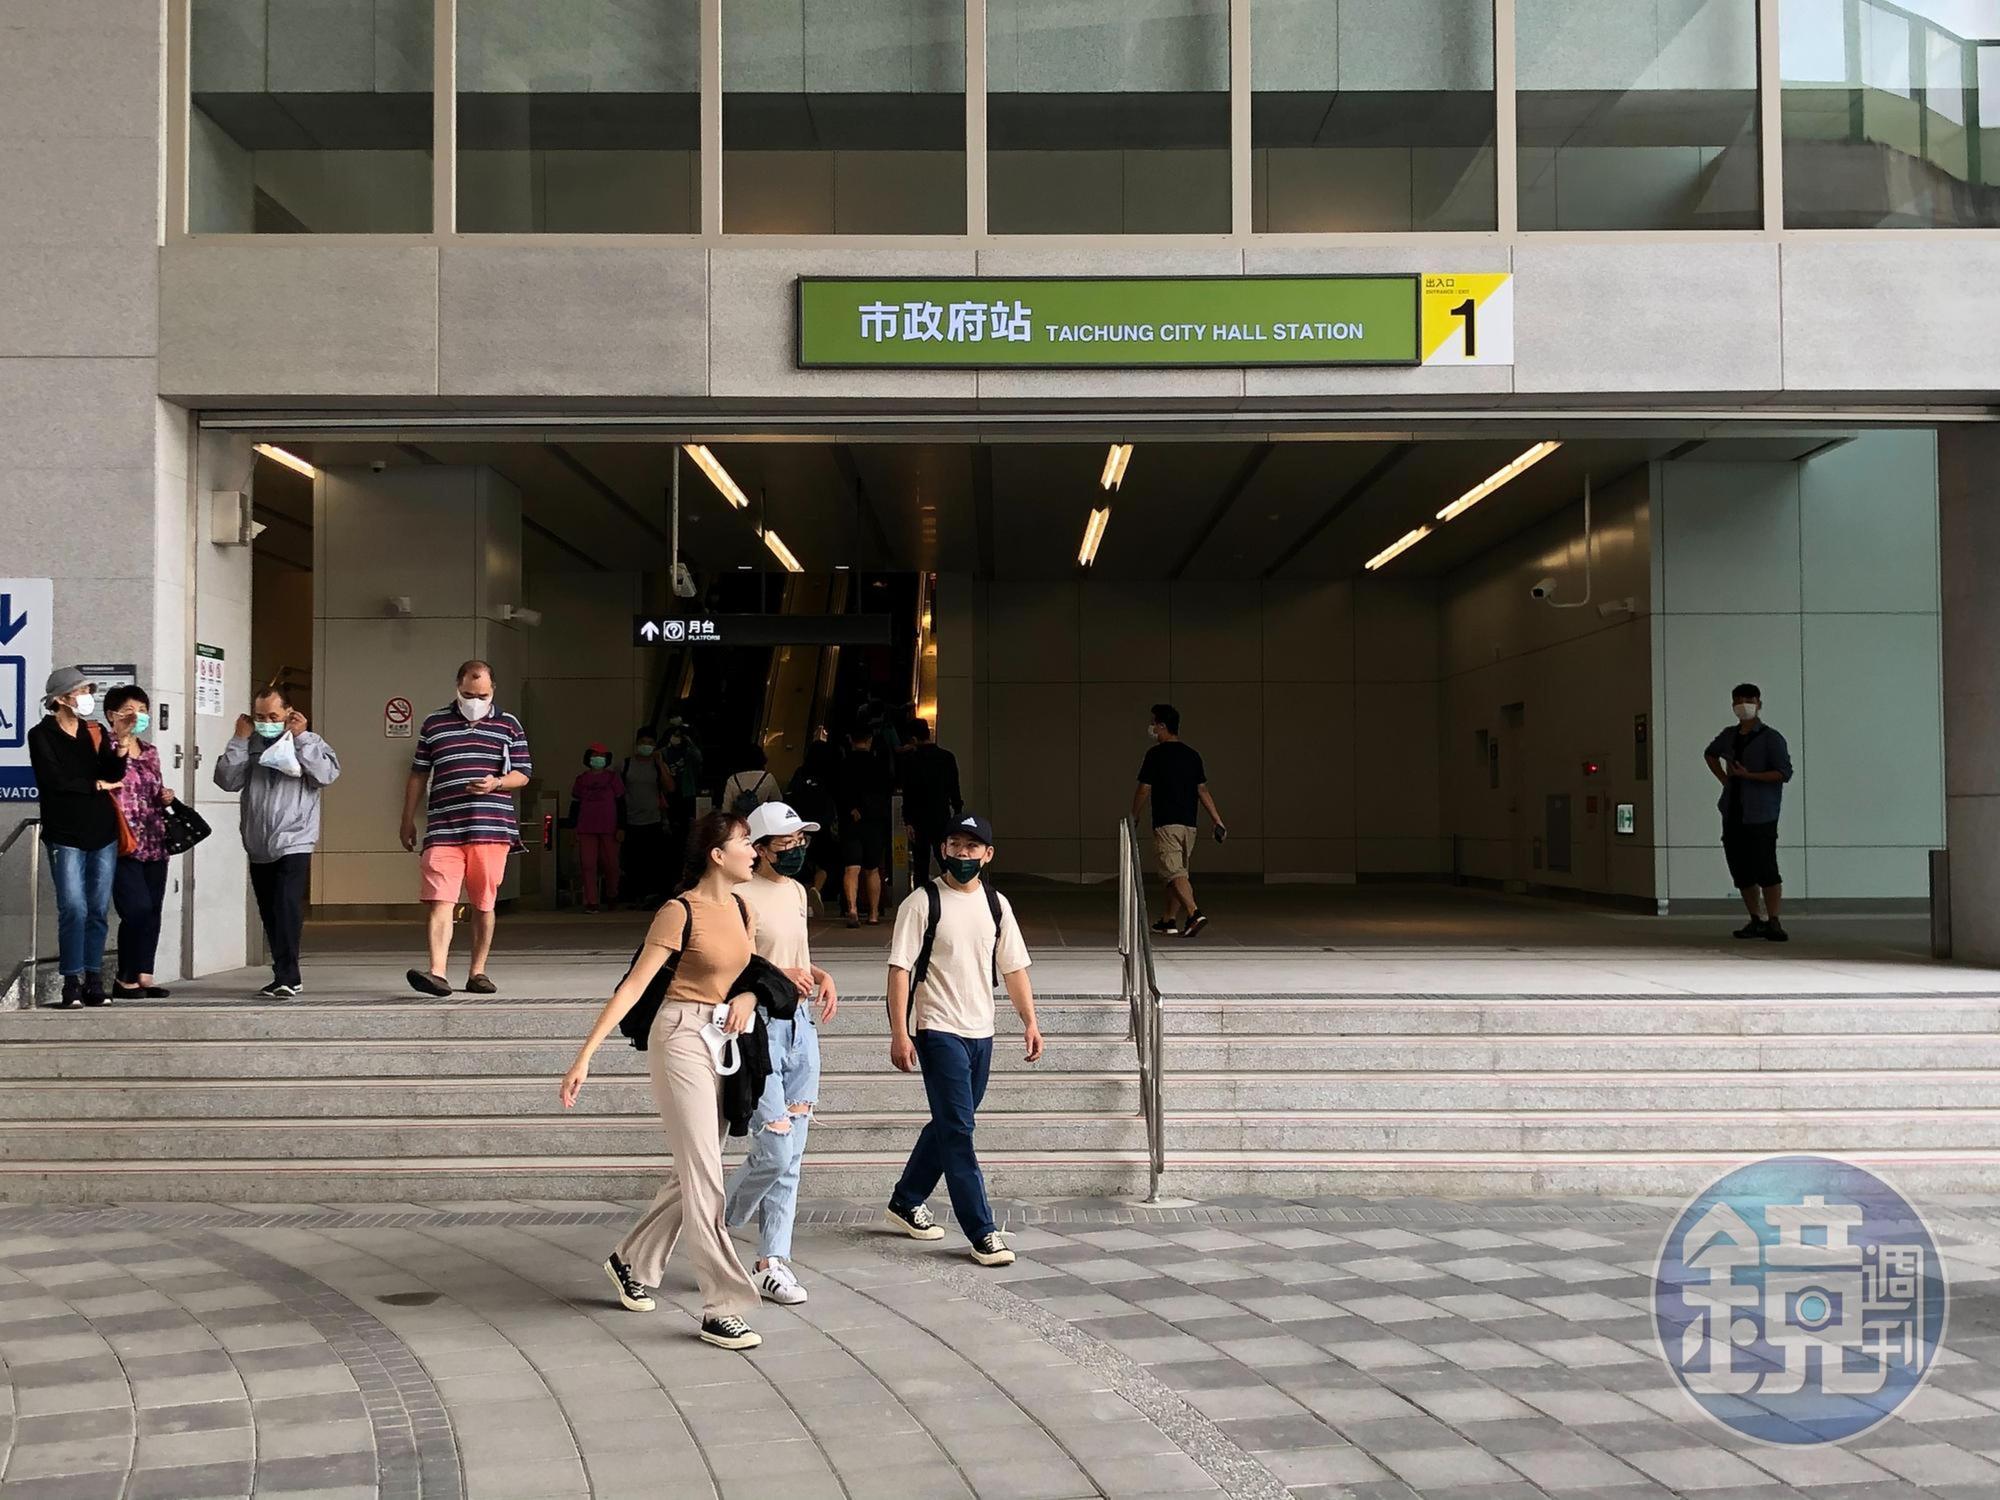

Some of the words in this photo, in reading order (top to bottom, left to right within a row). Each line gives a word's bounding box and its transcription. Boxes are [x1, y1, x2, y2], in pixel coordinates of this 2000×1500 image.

[1425, 278, 1454, 288] 出入口
[858, 301, 1032, 342] 市政府站
[1450, 299, 1475, 356] 1
[1046, 325, 1154, 341] TAICHUNG
[1159, 324, 1207, 341] CITY
[1212, 324, 1267, 340] HALL
[1273, 323, 1363, 340] STATION
[688, 619, 715, 634] 月台
[0, 787, 39, 798] VATO
